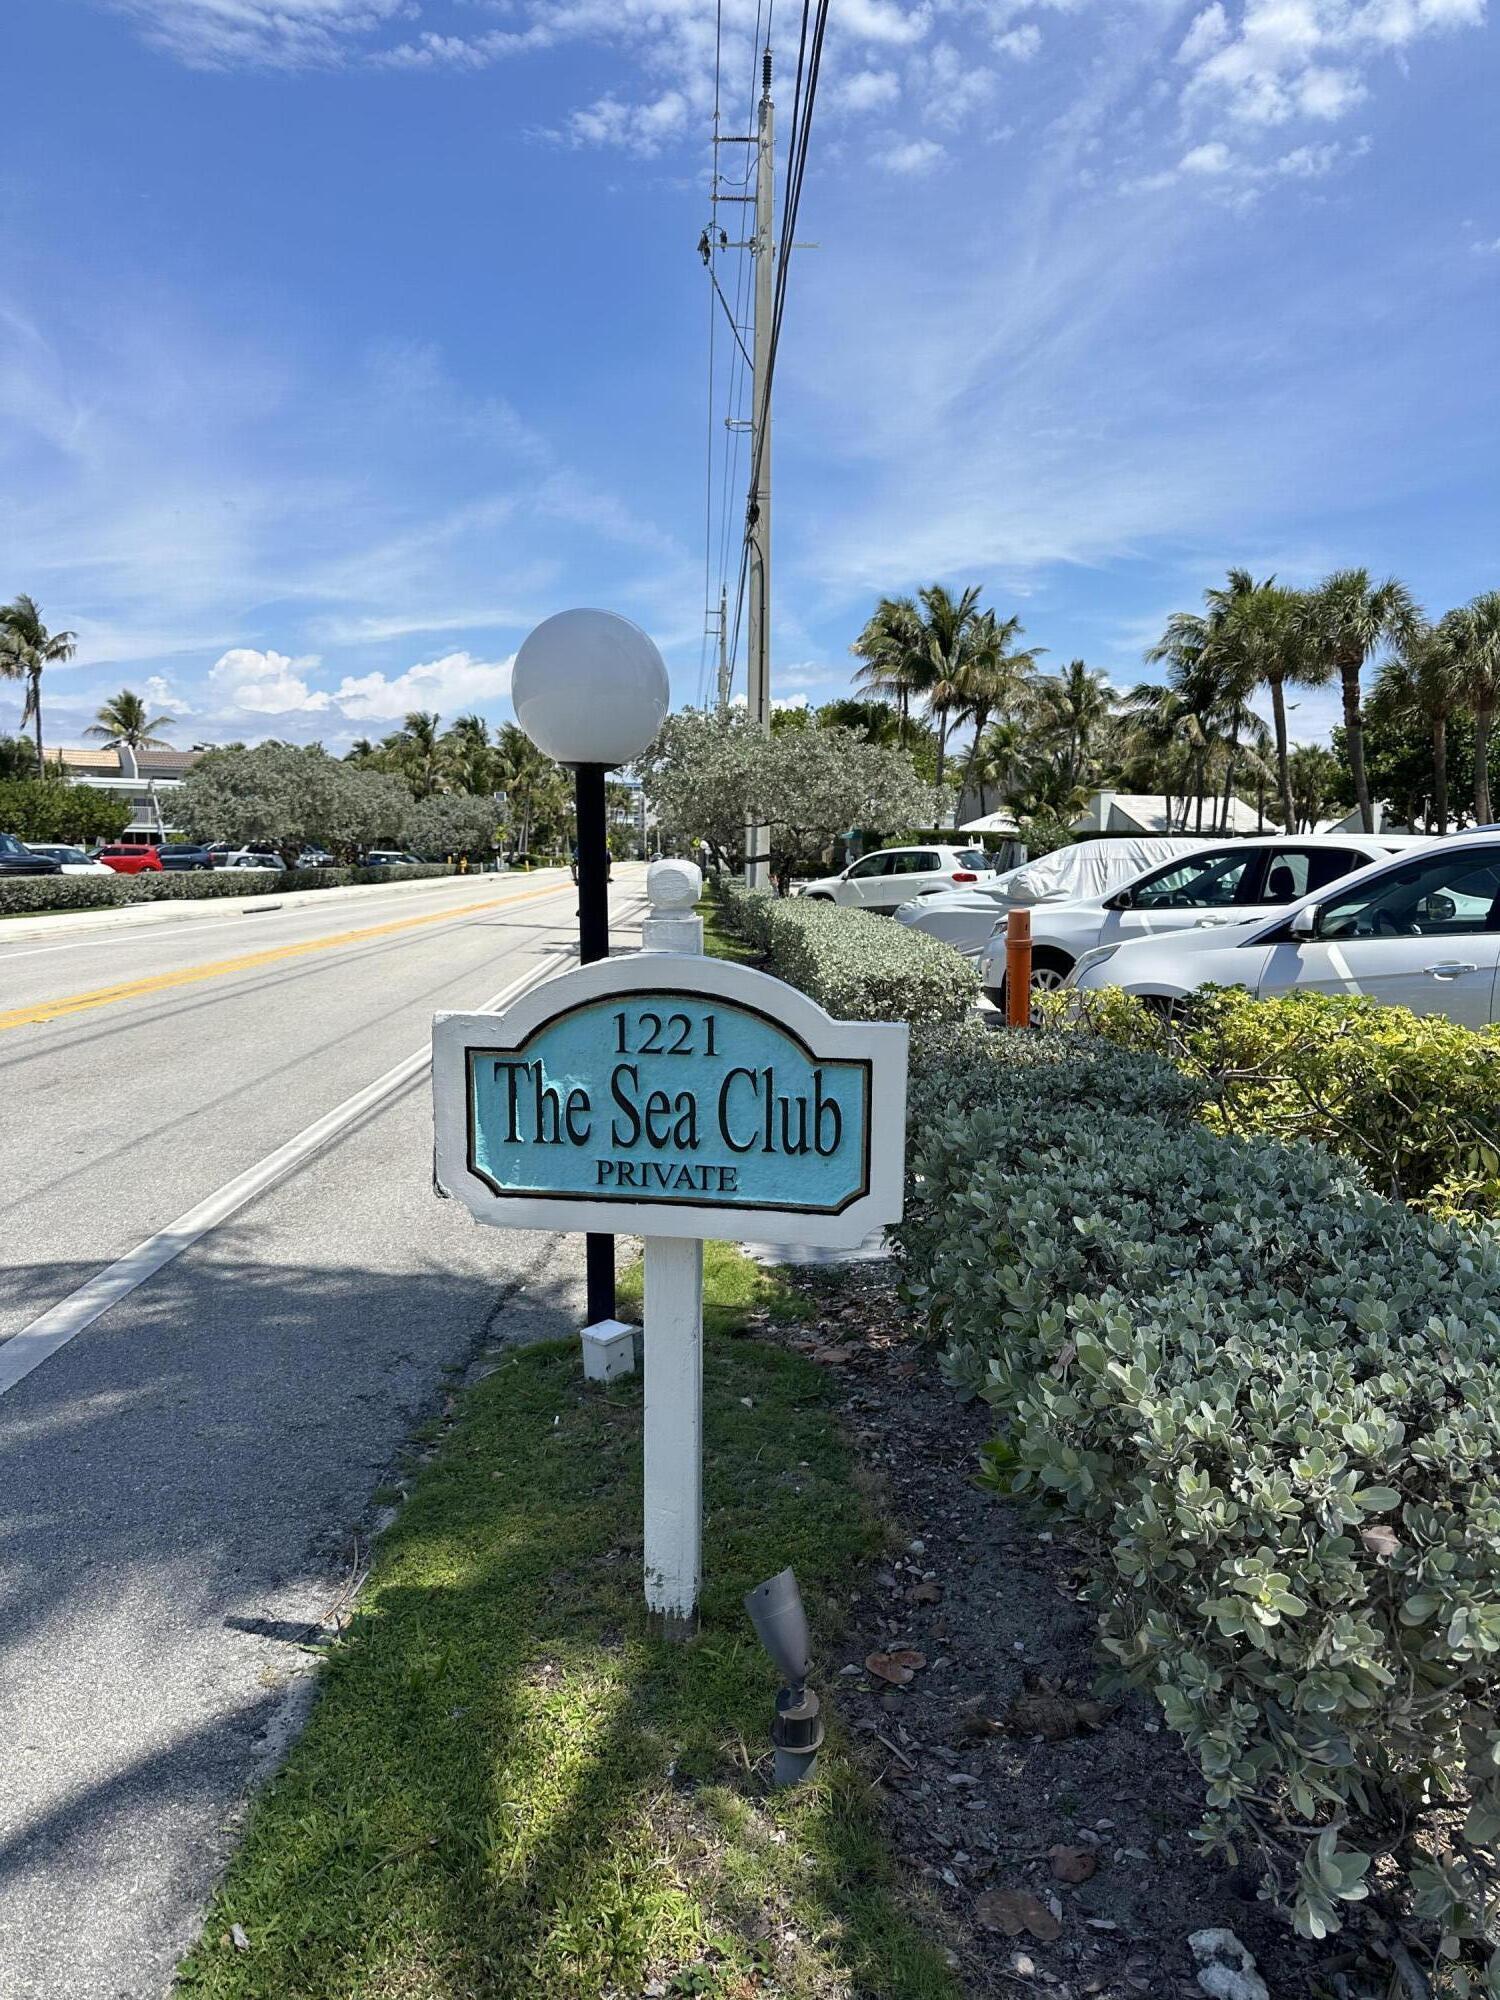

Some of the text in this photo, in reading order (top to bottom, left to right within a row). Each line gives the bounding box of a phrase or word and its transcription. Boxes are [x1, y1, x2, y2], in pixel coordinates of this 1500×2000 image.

[614, 1012, 719, 1056] 1221
[494, 1059, 842, 1156] The Sea Club
[596, 1159, 738, 1192] PRIVATE
